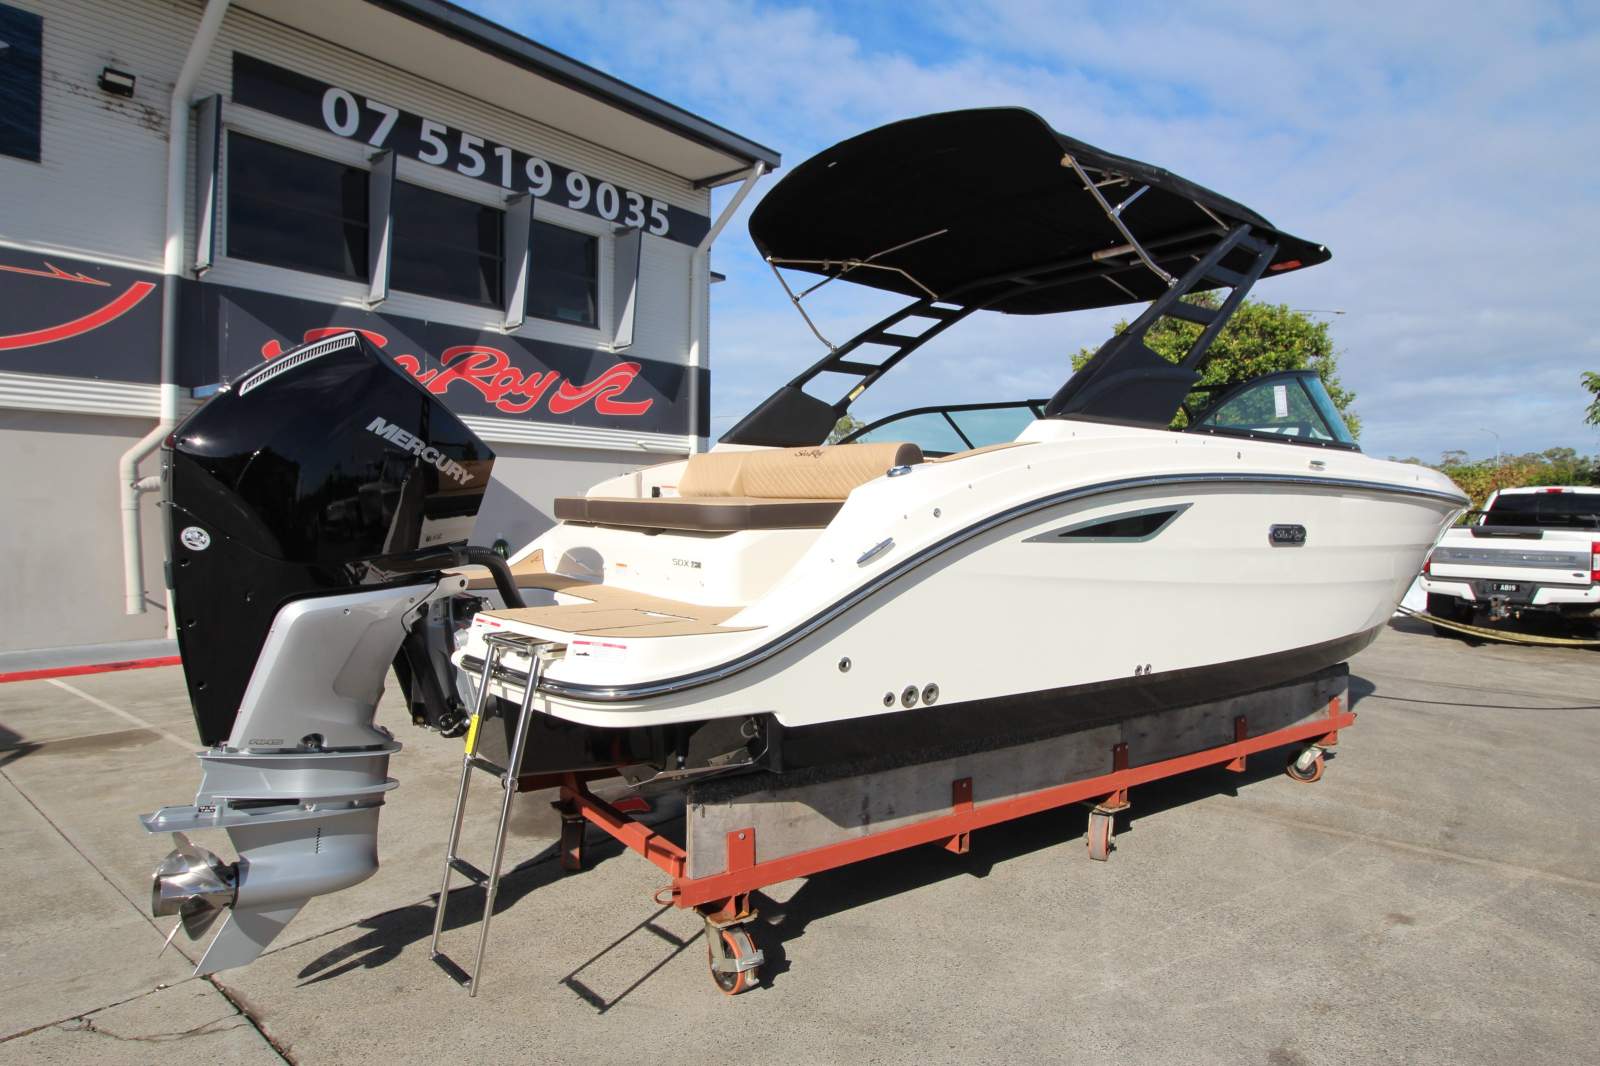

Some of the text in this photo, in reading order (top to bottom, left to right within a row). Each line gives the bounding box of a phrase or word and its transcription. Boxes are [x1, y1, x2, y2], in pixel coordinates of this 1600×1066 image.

[321, 87, 670, 236] 07 5519 9035
[365, 416, 475, 485] MERCURY
